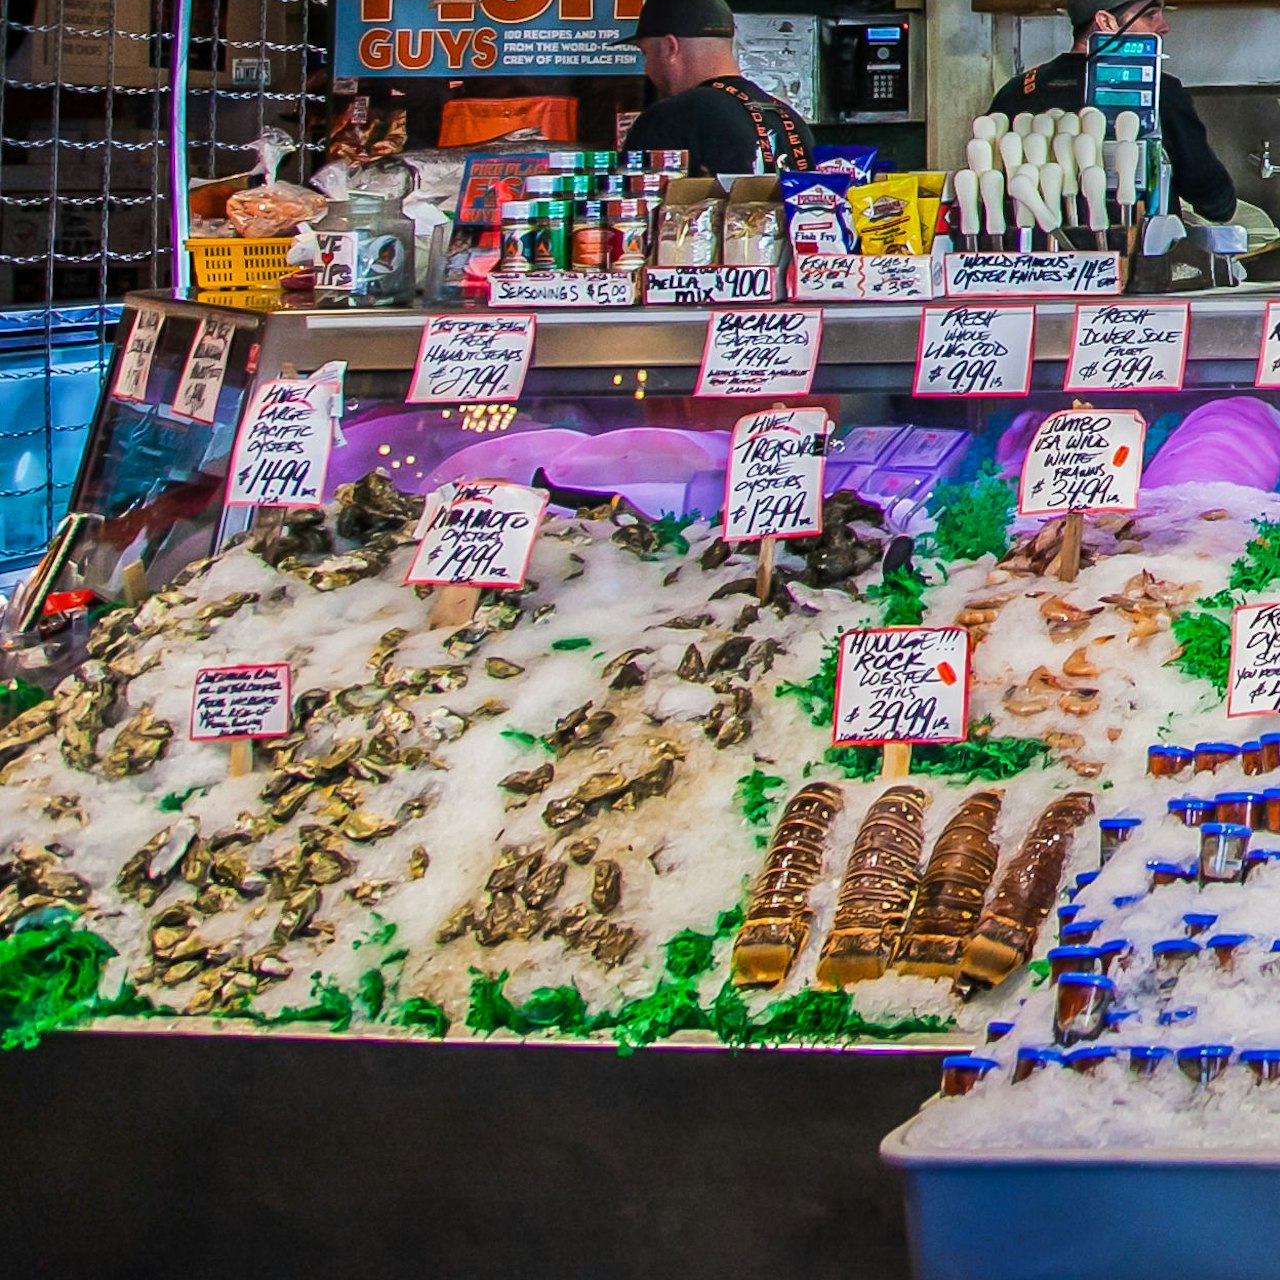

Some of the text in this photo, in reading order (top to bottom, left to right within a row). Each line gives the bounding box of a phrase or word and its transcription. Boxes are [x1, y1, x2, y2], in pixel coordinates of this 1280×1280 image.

[523, 29, 620, 40] RECIPES AND TIPS
[359, 27, 498, 71] GUYS
[503, 42, 534, 52] FROM
[536, 42, 559, 52] THE
[1124, 42, 1143, 53] 0.00
[503, 54, 637, 65] CREW OF PIKE PLACE FISH
[794, 232, 816, 241] Fish
[647, 274, 698, 291] PAELLA
[953, 269, 1007, 290] OYSTER
[498, 283, 579, 301] SEASONINGS
[1092, 305, 1155, 325] FRESH
[717, 312, 807, 338] BACALAO
[1141, 328, 1182, 342] SOLE
[262, 383, 316, 403] LIVE!
[257, 406, 313, 422] LARGE
[748, 412, 795, 434] LIVE!
[1040, 416, 1111, 435] JUMBO
[248, 425, 315, 440] PACIFIC
[247, 440, 305, 463] OYSTERS
[1034, 433, 1110, 453] USA WILD
[1044, 451, 1103, 468] WHITE
[746, 461, 793, 478] COVE
[734, 474, 805, 502] OYSTERS
[440, 529, 501, 546] OYSTERS
[854, 652, 926, 672] ROCK
[860, 668, 943, 686] LOBSTER
[870, 685, 920, 700] TAILS
